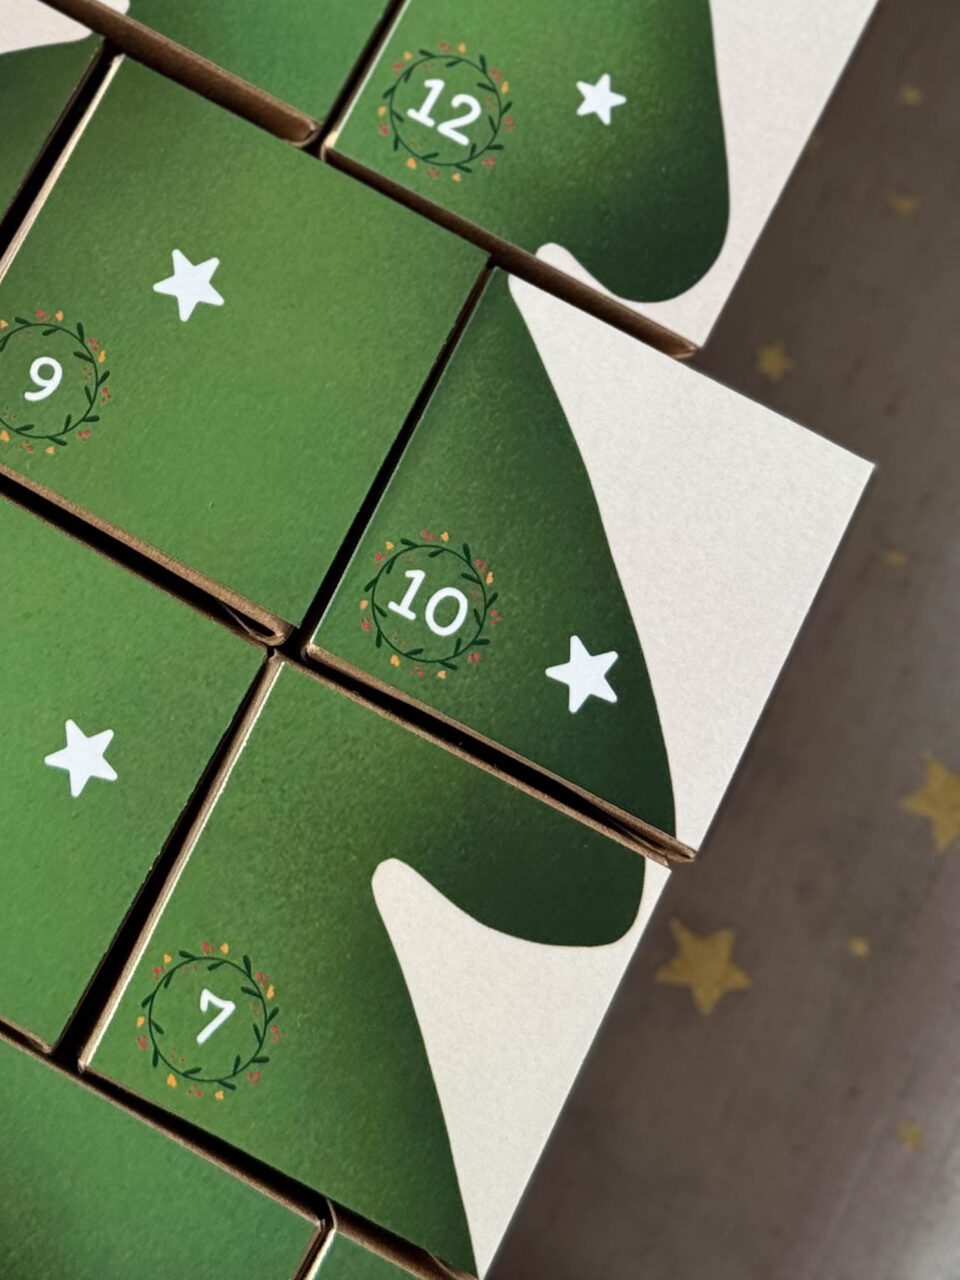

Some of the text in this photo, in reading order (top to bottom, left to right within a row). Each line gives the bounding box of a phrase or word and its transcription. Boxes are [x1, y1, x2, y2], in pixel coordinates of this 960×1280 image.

[406, 78, 482, 146] 12
[24, 356, 63, 402] 9
[387, 569, 468, 637] 10
[196, 988, 236, 1045] 7
